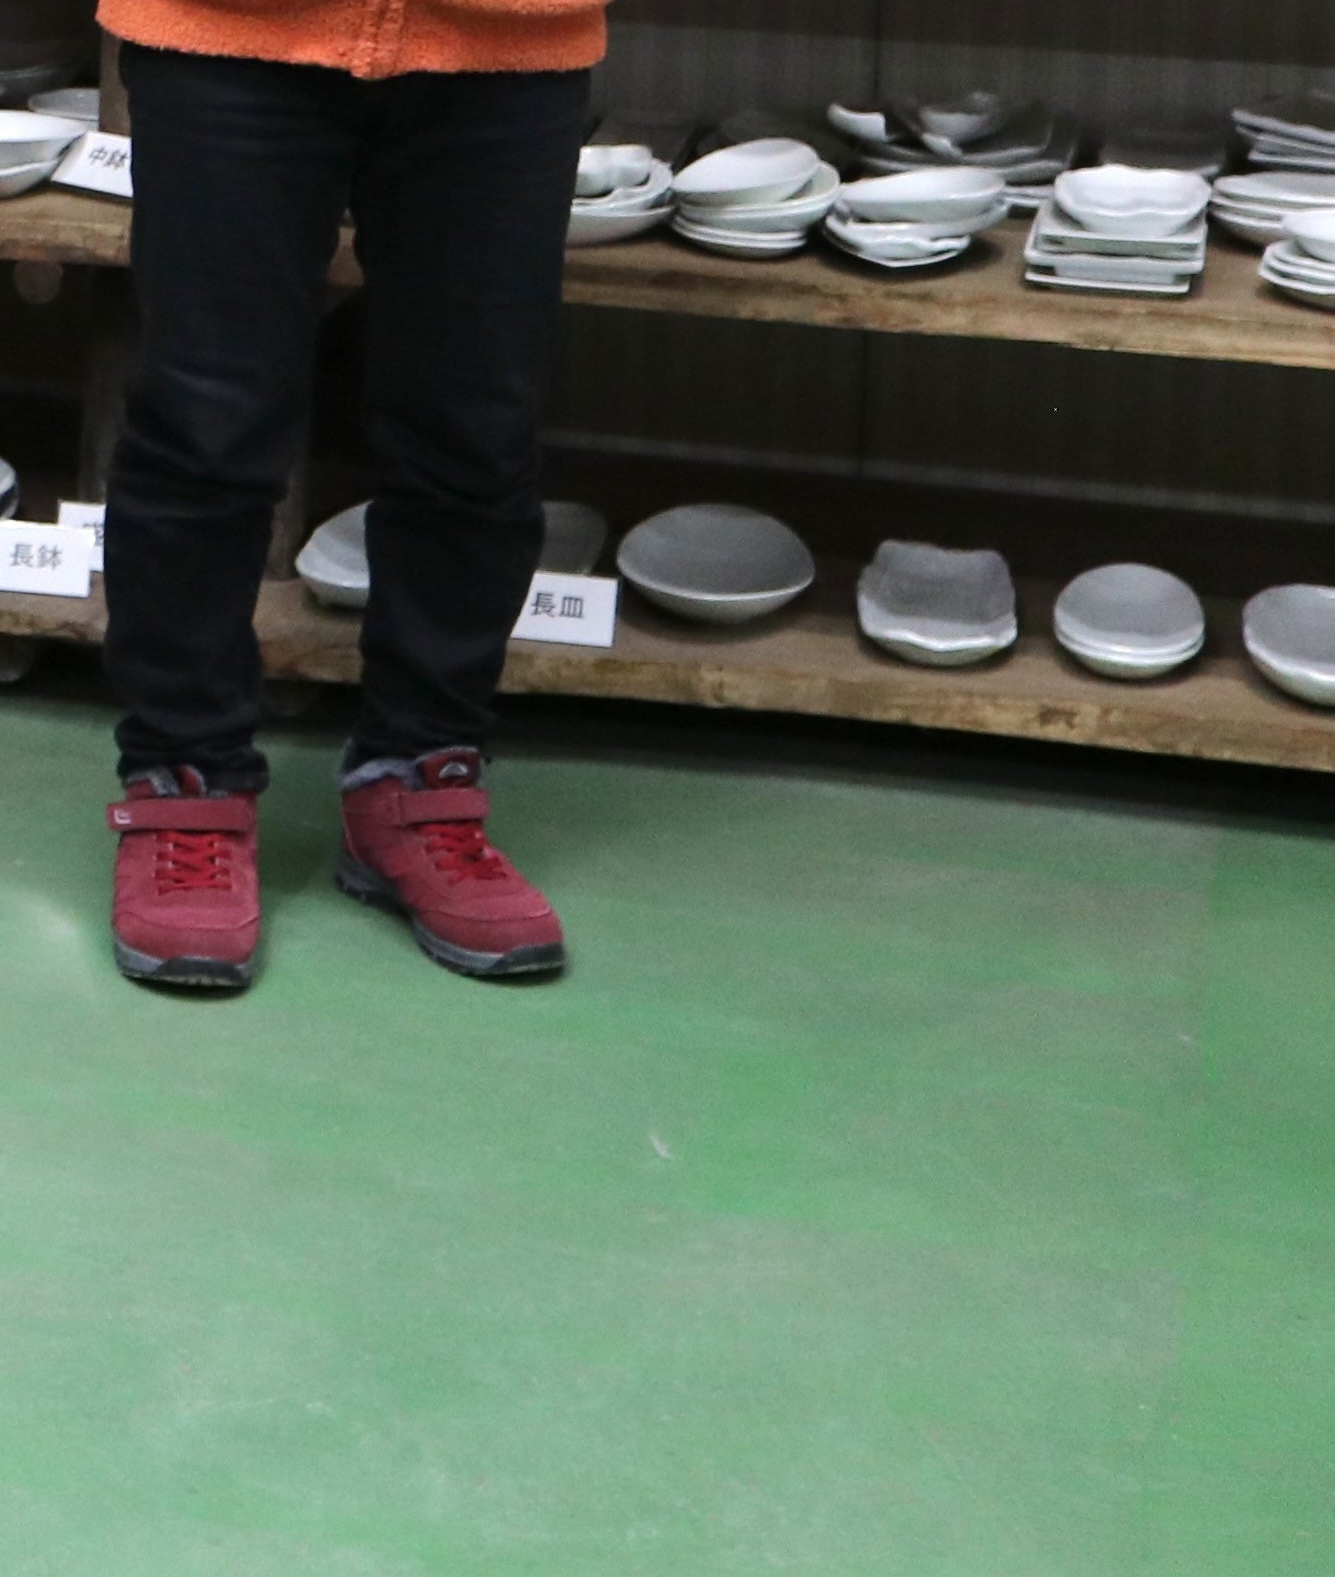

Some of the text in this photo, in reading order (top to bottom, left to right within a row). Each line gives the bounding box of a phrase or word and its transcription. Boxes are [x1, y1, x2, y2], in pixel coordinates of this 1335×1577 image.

[88, 146, 130, 171] 中鉢
[10, 543, 63, 571] 長鉢
[530, 591, 585, 619] 長皿
